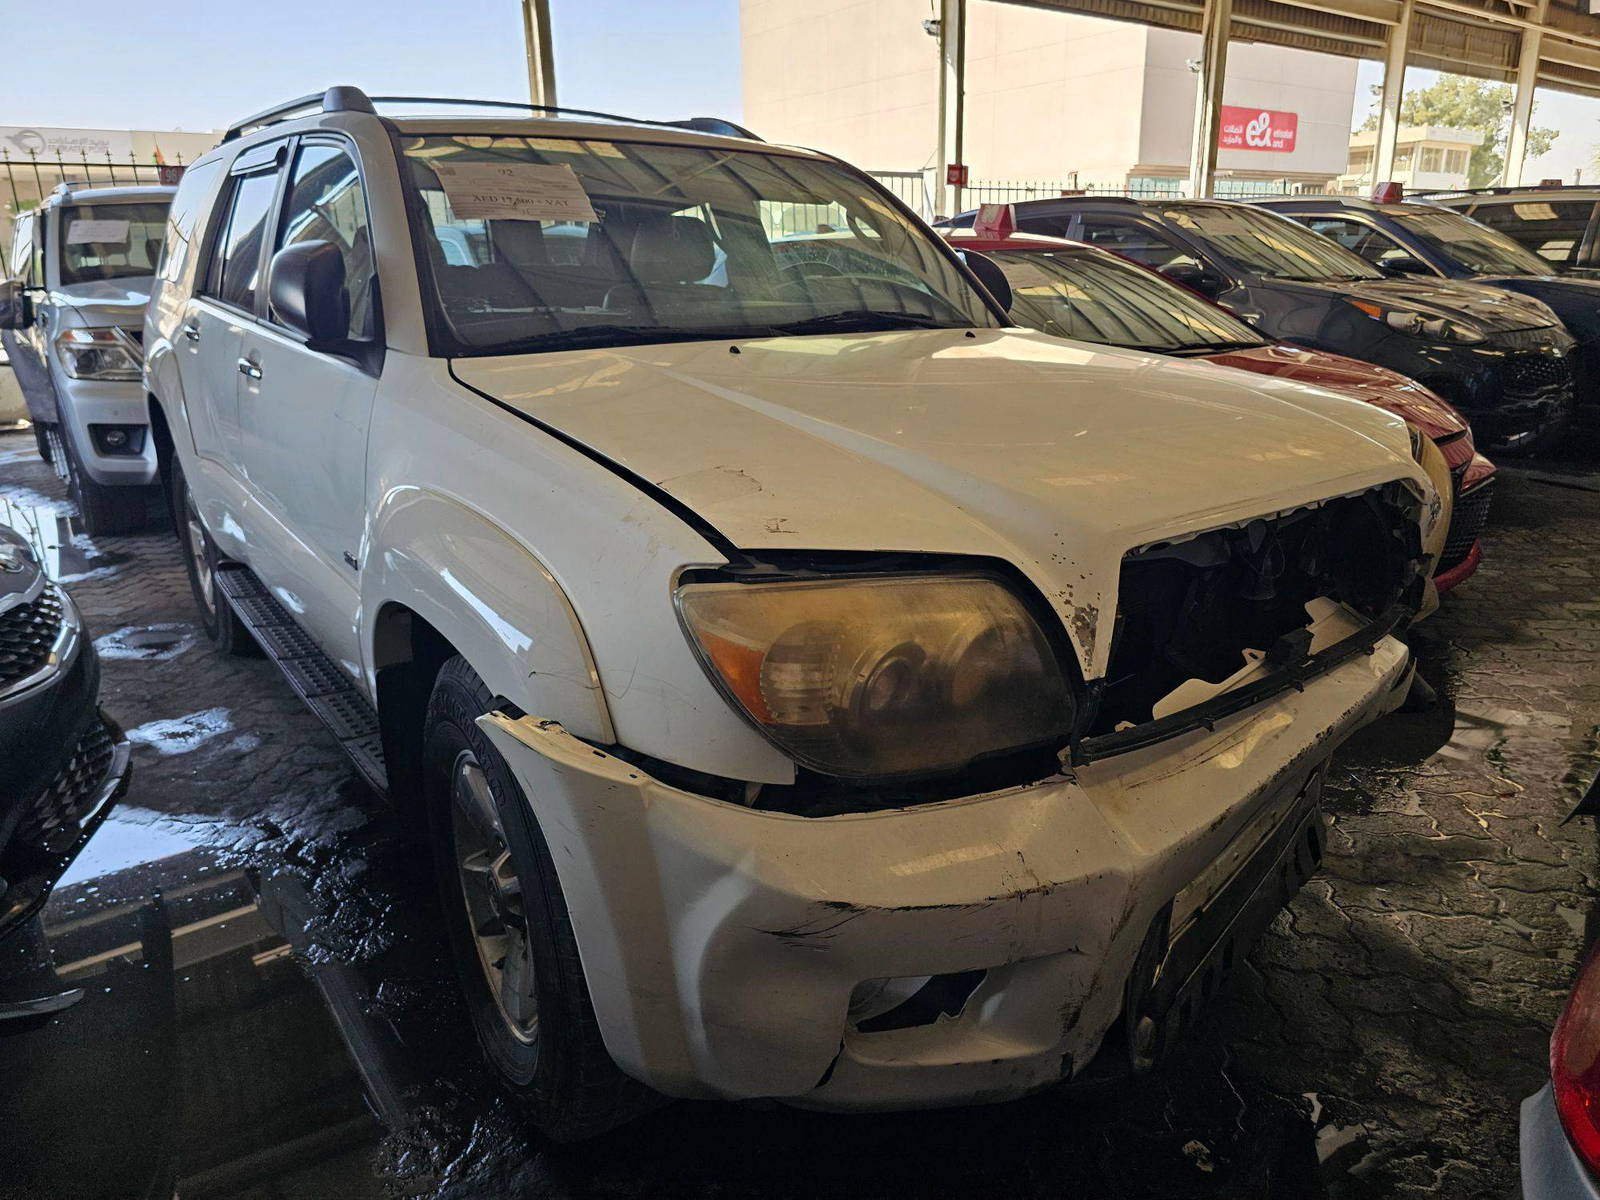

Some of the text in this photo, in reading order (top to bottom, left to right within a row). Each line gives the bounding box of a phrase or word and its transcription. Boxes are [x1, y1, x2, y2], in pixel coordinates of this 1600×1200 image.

[1273, 130, 1293, 138] etisalat
[1272, 139, 1284, 148] and
[472, 194, 498, 202] AED
[545, 199, 569, 207] VAT
